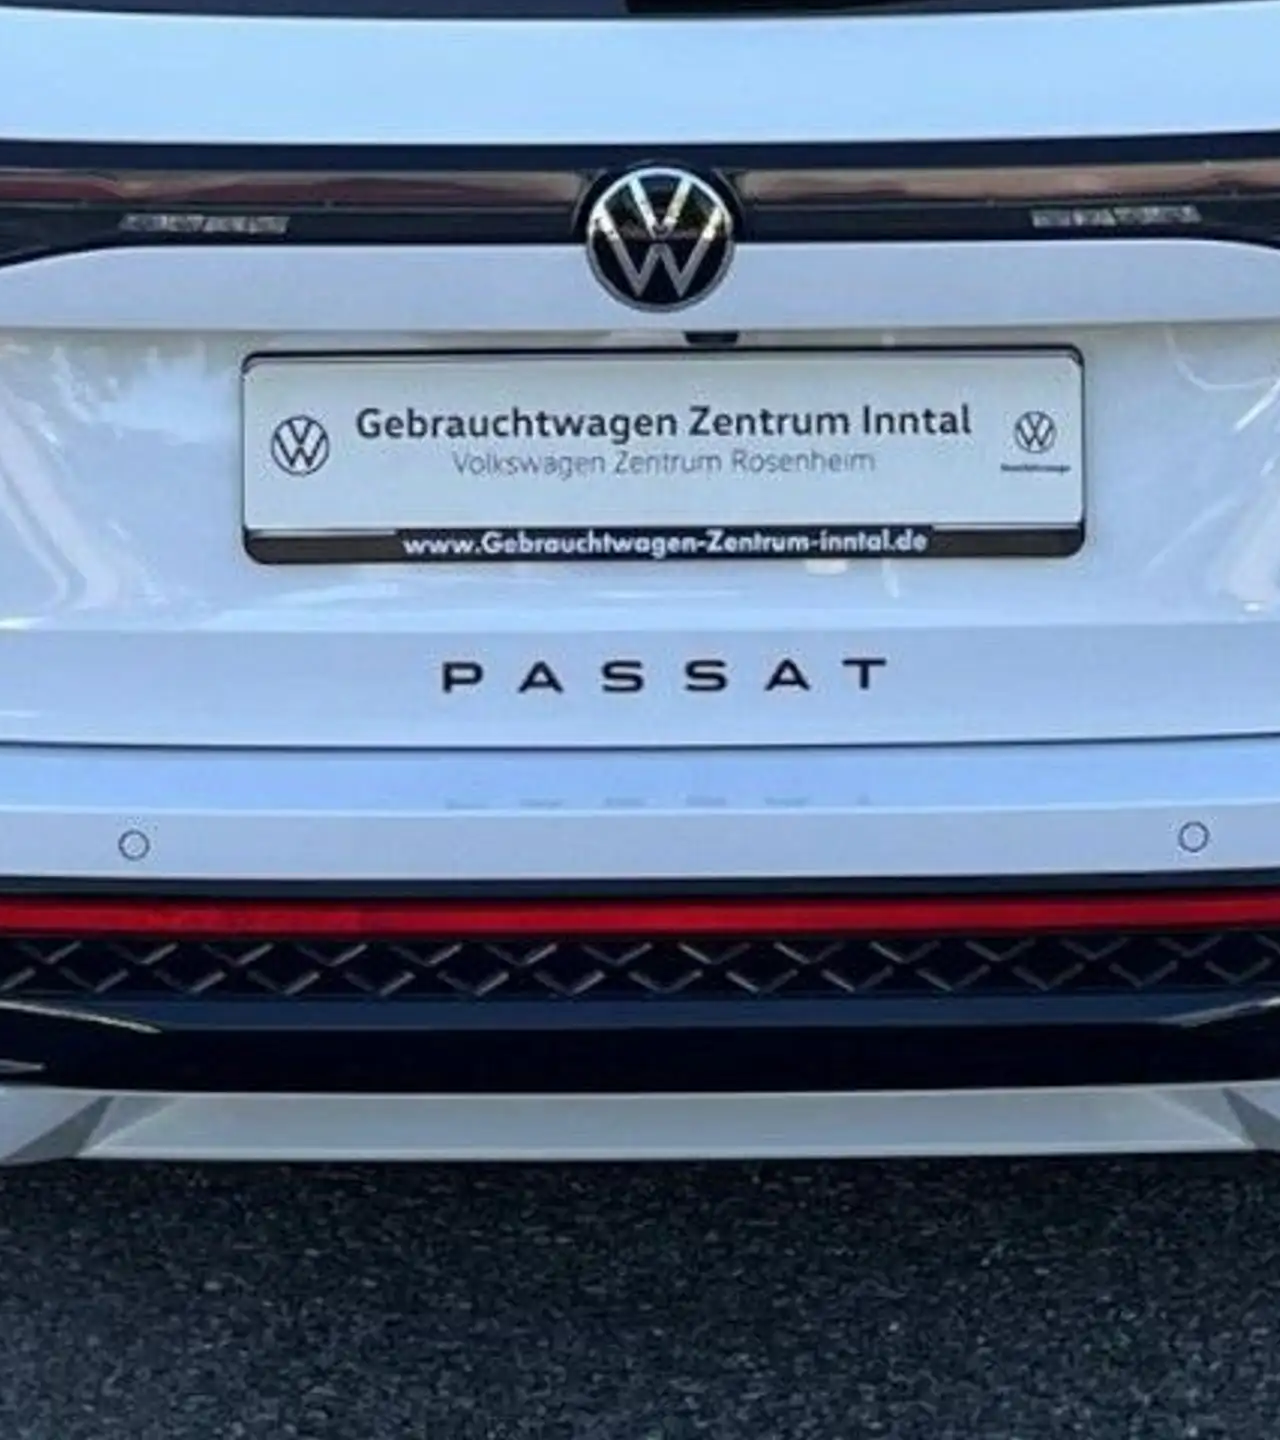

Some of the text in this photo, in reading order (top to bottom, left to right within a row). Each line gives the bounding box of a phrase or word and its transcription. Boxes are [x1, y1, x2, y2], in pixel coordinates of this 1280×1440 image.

[587, 167, 734, 313] VW
[355, 403, 972, 446] Gebrauchtwagen Zentrum Inntal
[451, 447, 876, 482] Volkswagen Zentrum Rosenheim
[403, 528, 928, 560] www.Gebrauchtwagen-Zentrum-inntal.de
[442, 658, 887, 694] PASSAT
